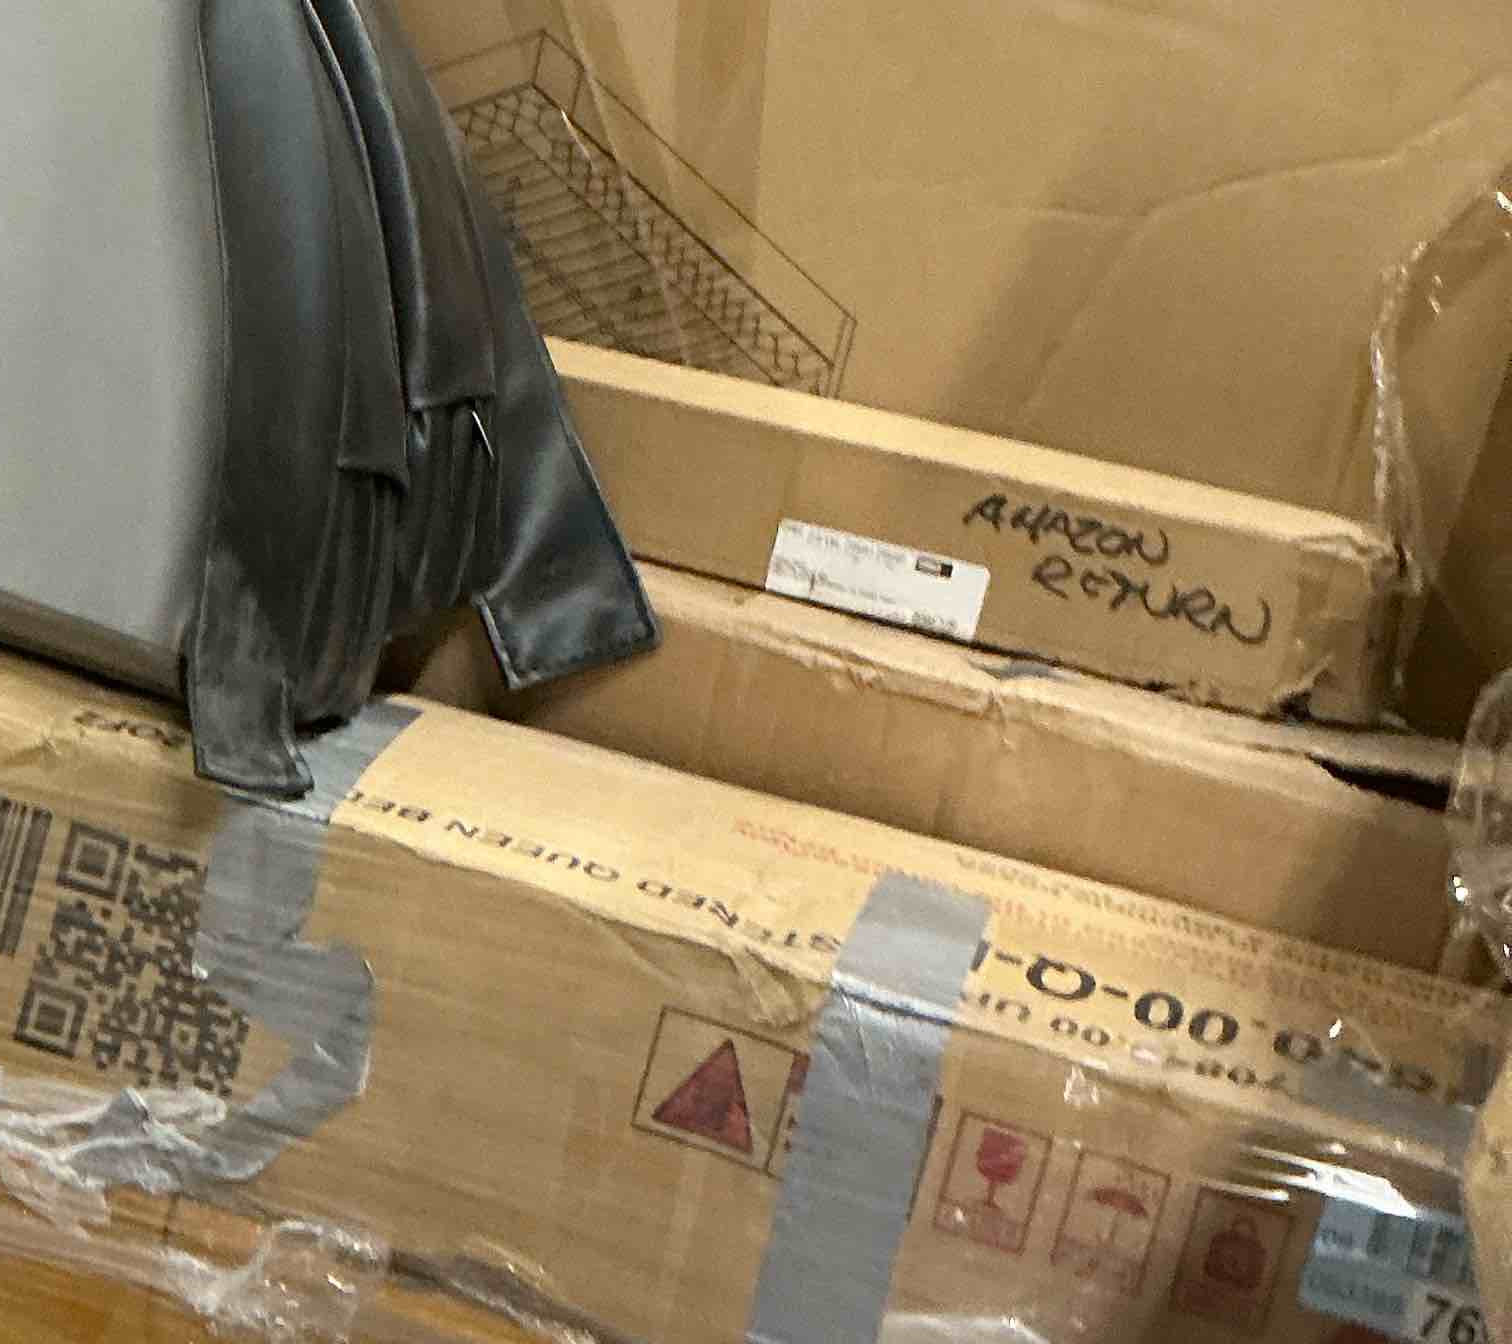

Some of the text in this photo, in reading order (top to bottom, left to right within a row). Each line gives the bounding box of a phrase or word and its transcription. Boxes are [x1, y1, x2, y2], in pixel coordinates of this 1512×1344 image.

[962, 494, 1170, 567] AMAZON
[1031, 556, 1272, 645] RETURN
[445, 817, 621, 883] QUEEN
